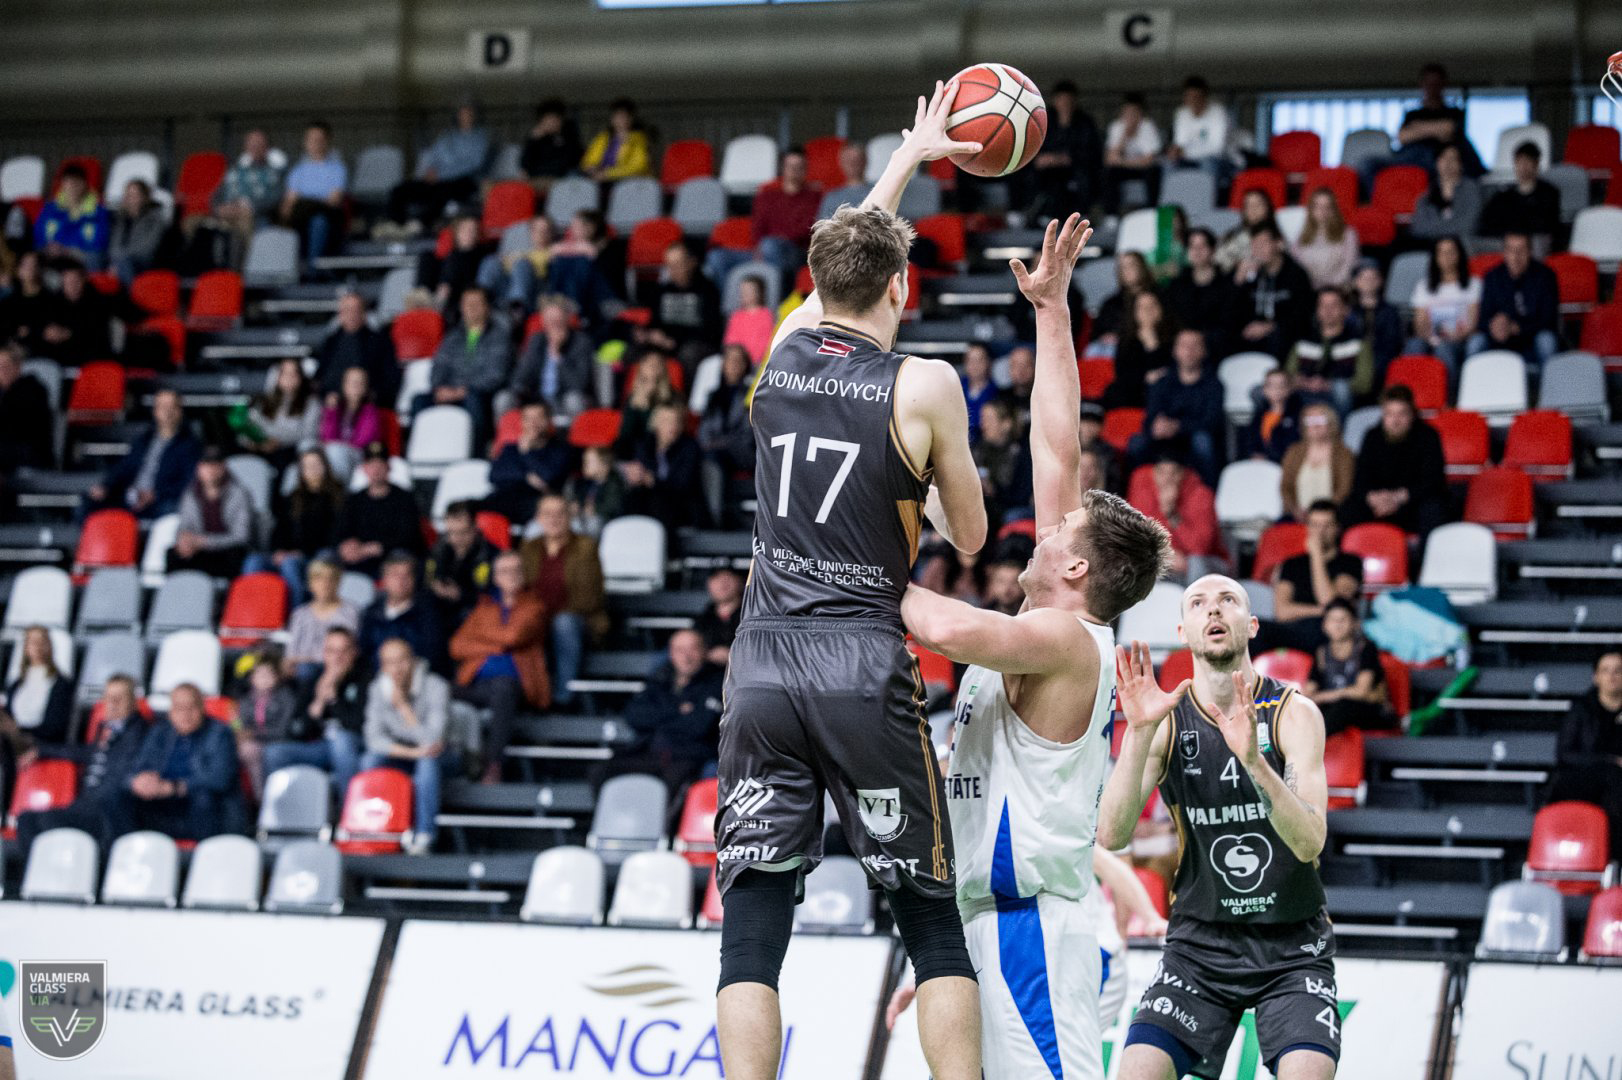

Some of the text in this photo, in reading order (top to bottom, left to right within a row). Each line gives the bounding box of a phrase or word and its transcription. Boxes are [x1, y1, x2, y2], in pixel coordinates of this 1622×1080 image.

[1122, 14, 1152, 48] C
[484, 34, 511, 66] D
[767, 369, 891, 403] VOINALOVYCH
[770, 432, 861, 525] 17
[817, 560, 884, 577] UNIVERSITY
[835, 574, 893, 587] SCIENCES
[1220, 757, 1240, 788] 4
[863, 797, 897, 817] VT
[1220, 896, 1275, 907] VALMIERA
[1231, 905, 1267, 915] GLASS
[32, 986, 303, 1018] ALMIERA GLASS
[1172, 1006, 1199, 1032] MEŽS
[1315, 1005, 1339, 1039] 4
[442, 1013, 793, 1080] MANGAI
[1506, 1039, 1622, 1080] SUN
